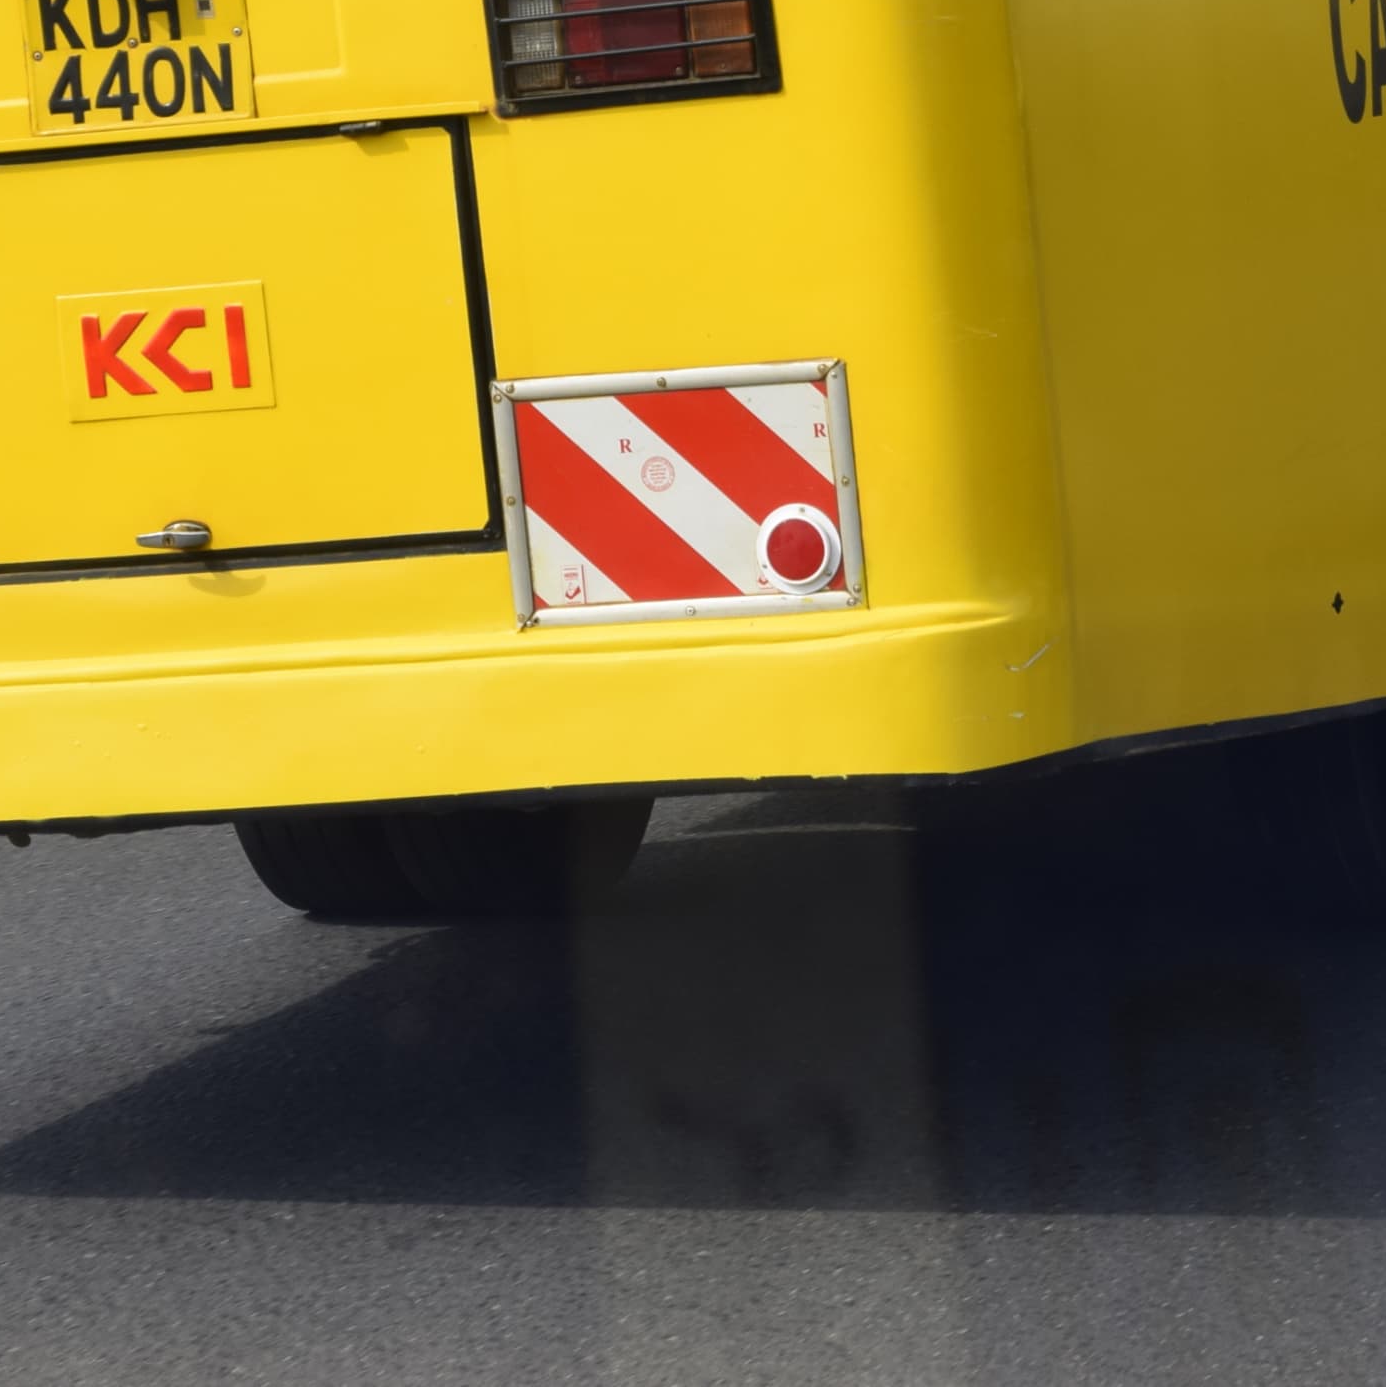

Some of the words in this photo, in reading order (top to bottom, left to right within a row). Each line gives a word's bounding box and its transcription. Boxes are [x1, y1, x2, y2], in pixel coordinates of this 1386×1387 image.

[48, 43, 235, 124] 440N
[81, 304, 252, 399] KCI
[619, 438, 633, 454] R
[813, 423, 826, 438] R
